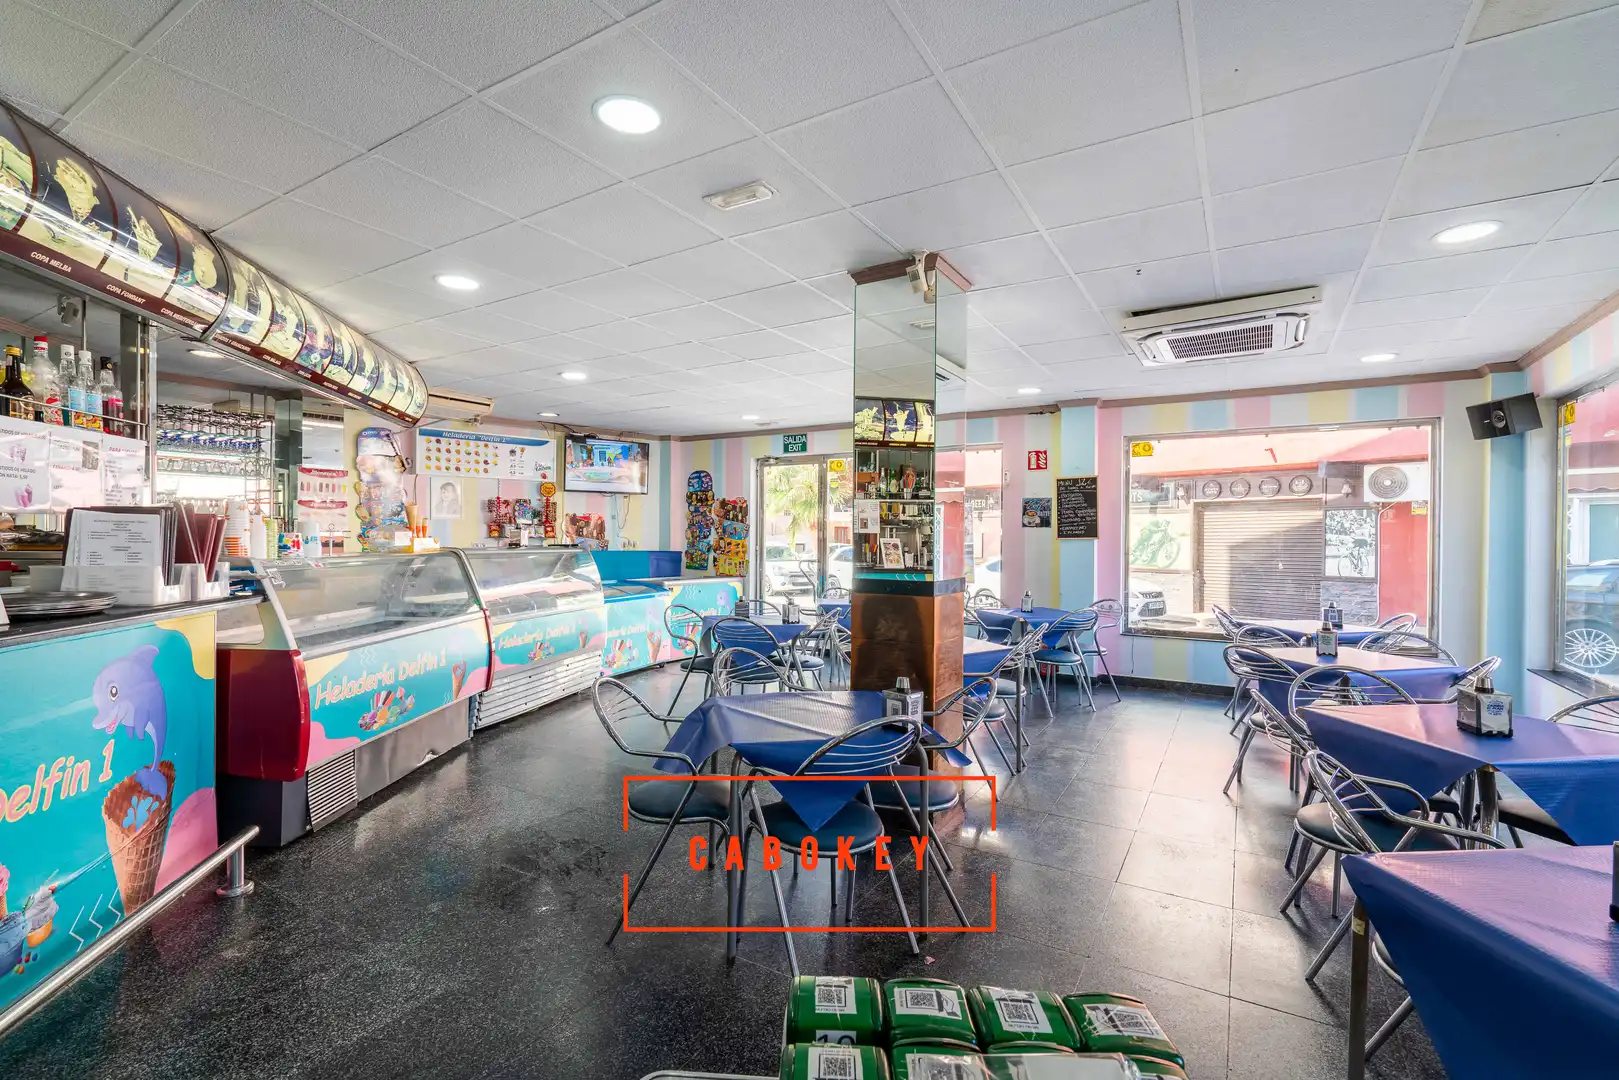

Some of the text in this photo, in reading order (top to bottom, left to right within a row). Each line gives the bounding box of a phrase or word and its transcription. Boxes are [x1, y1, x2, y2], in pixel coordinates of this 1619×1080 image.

[30, 251, 72, 273] COPA MELBA
[106, 284, 147, 304] COPA FONDANT
[783, 435, 807, 444] SALIDA
[788, 444, 802, 452] EXIT
[398, 652, 438, 681] Delfin
[439, 647, 447, 668] 1
[99, 739, 115, 783] 1
